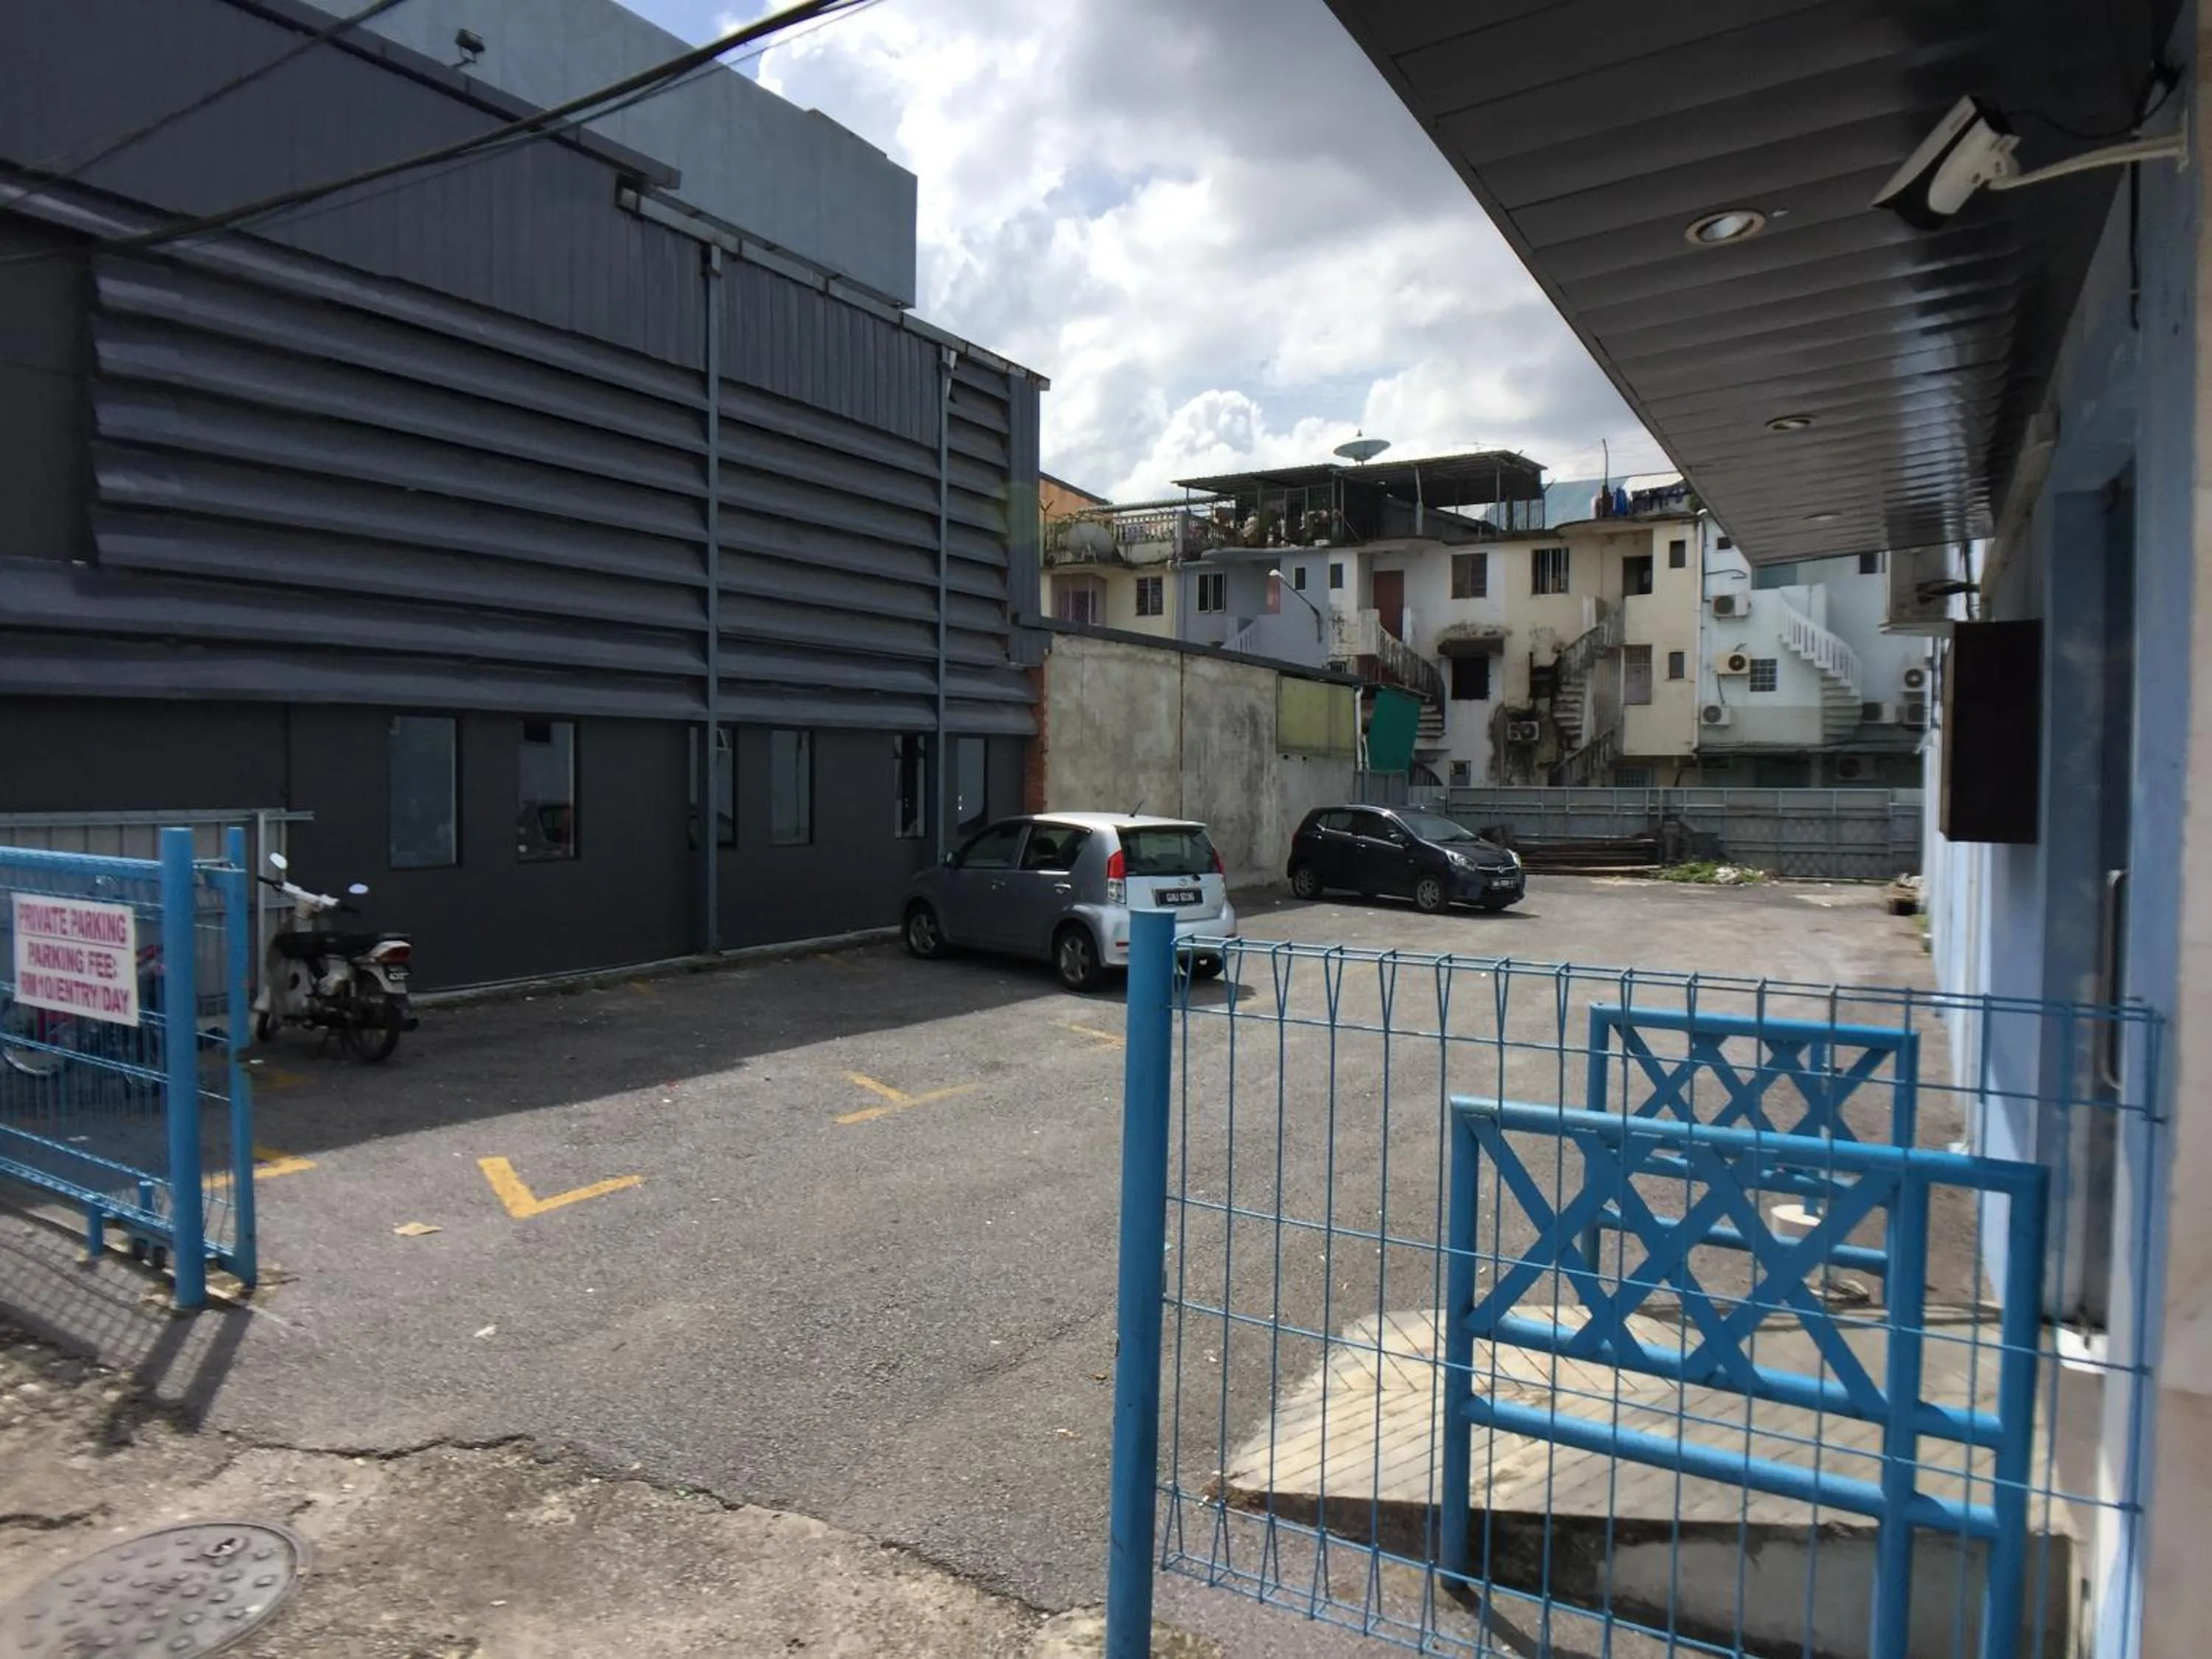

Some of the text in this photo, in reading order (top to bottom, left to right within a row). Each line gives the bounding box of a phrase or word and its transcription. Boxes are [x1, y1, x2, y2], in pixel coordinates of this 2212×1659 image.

[19, 902, 127, 944] PRIVATE PARKING
[27, 941, 84, 974] PARKING
